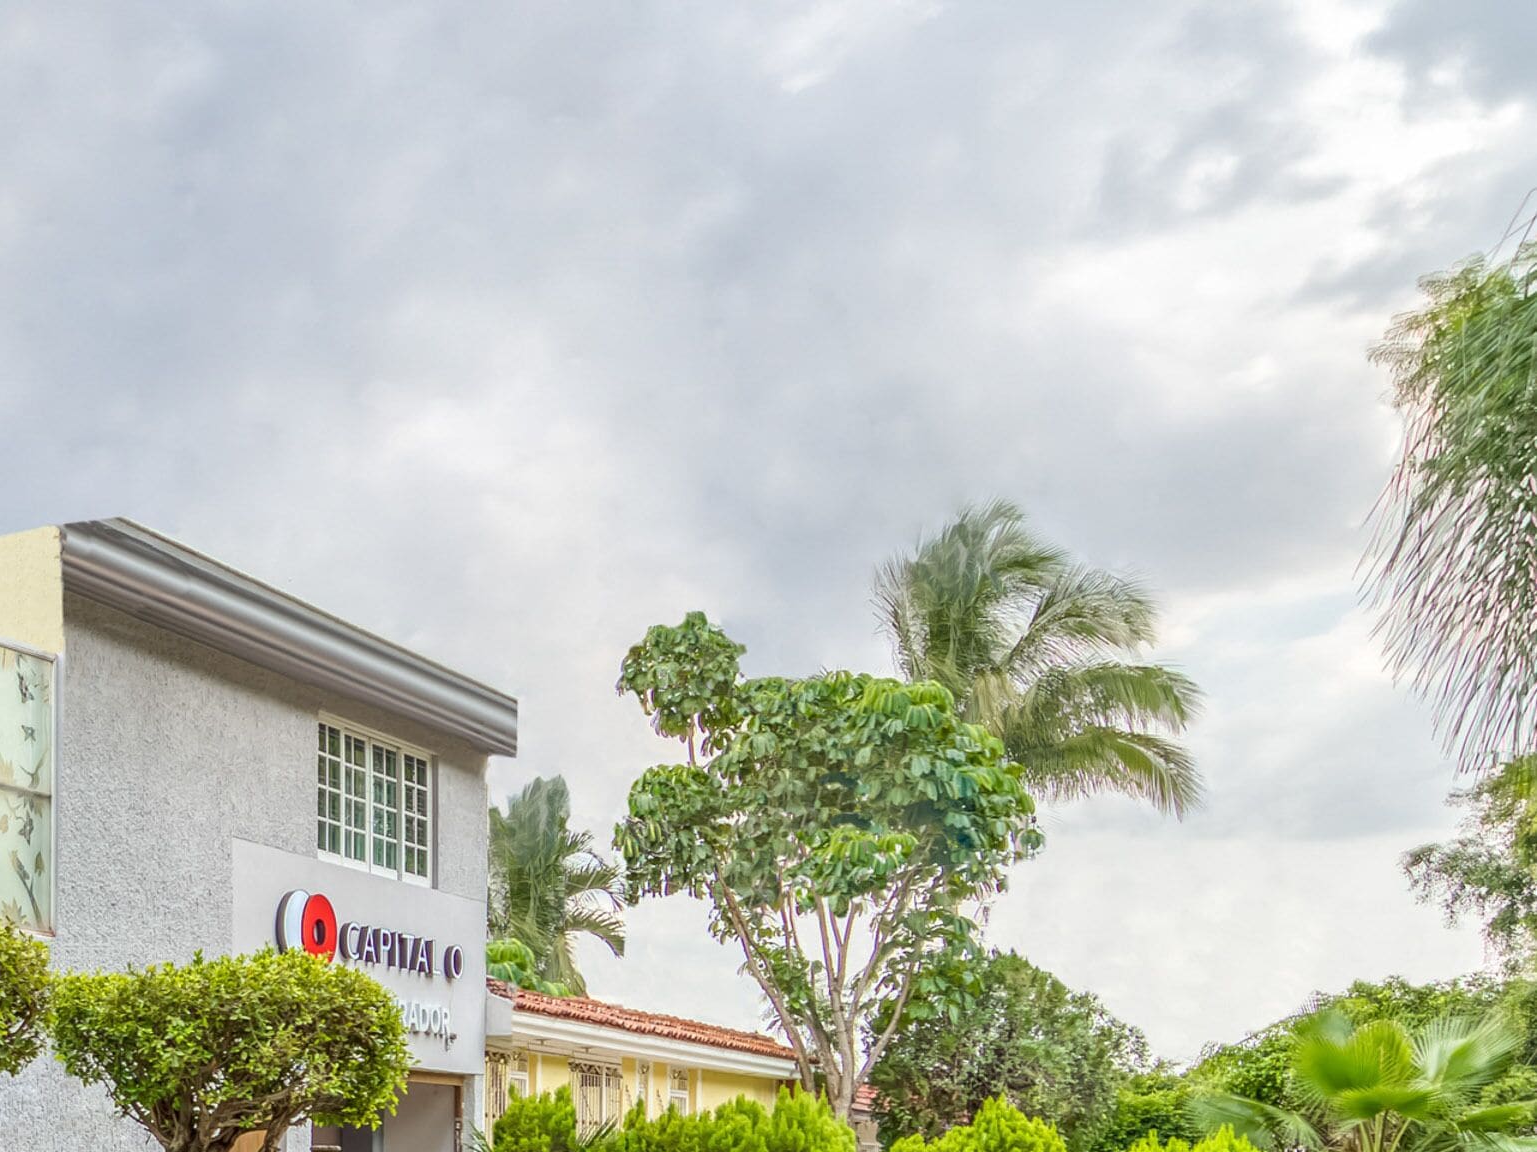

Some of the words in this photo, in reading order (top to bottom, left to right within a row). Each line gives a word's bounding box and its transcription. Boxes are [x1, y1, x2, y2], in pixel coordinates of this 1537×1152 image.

[340, 922, 441, 976] CAPITAL
[444, 945, 464, 979] O
[394, 1000, 451, 1035] RADOR
